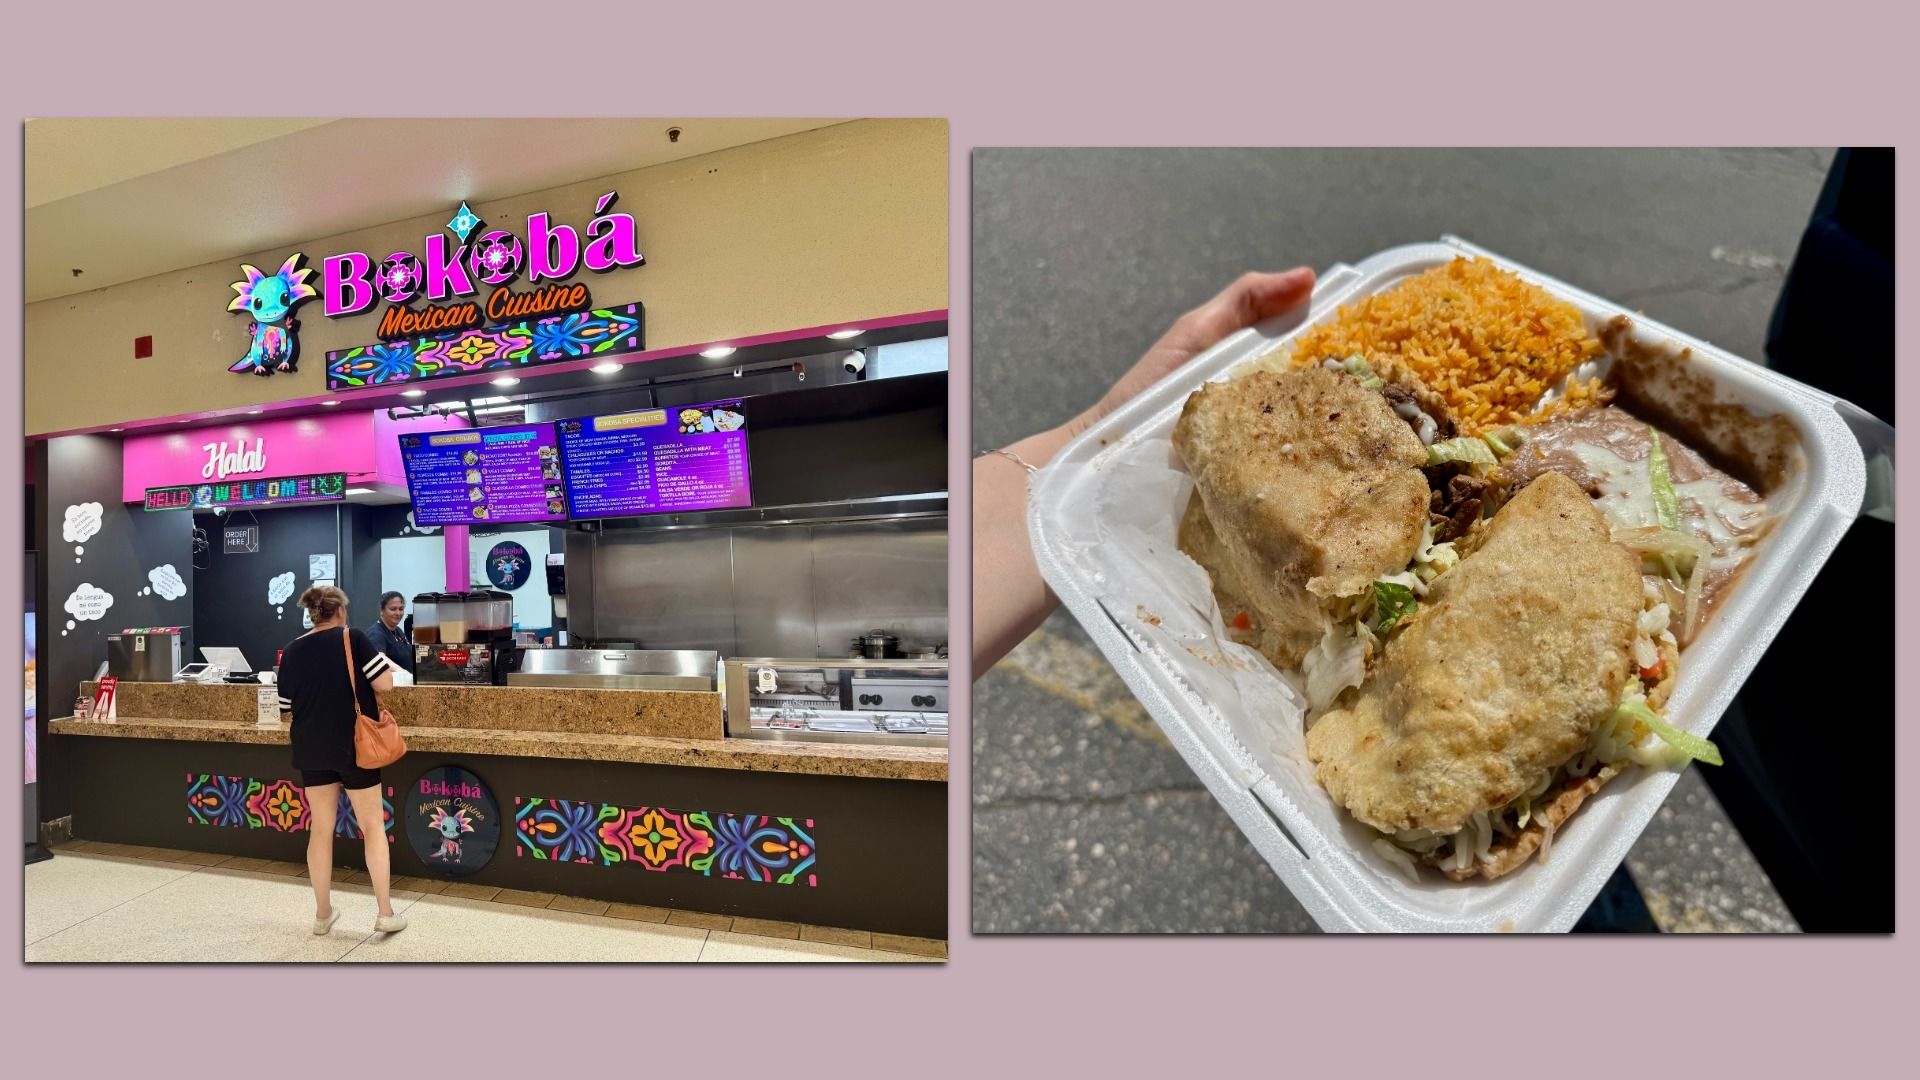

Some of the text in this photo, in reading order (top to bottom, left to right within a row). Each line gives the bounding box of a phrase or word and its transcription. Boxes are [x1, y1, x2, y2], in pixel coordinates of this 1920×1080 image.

[323, 191, 644, 317] Bokobá
[379, 282, 588, 338] Mexican Cuisine
[202, 437, 267, 480] Halal
[148, 490, 189, 508] HELLO
[225, 530, 248, 539] ORDER
[227, 538, 245, 546] HERE
[419, 779, 483, 799] Bokobá
[418, 797, 485, 822] Mexican Cuisine
